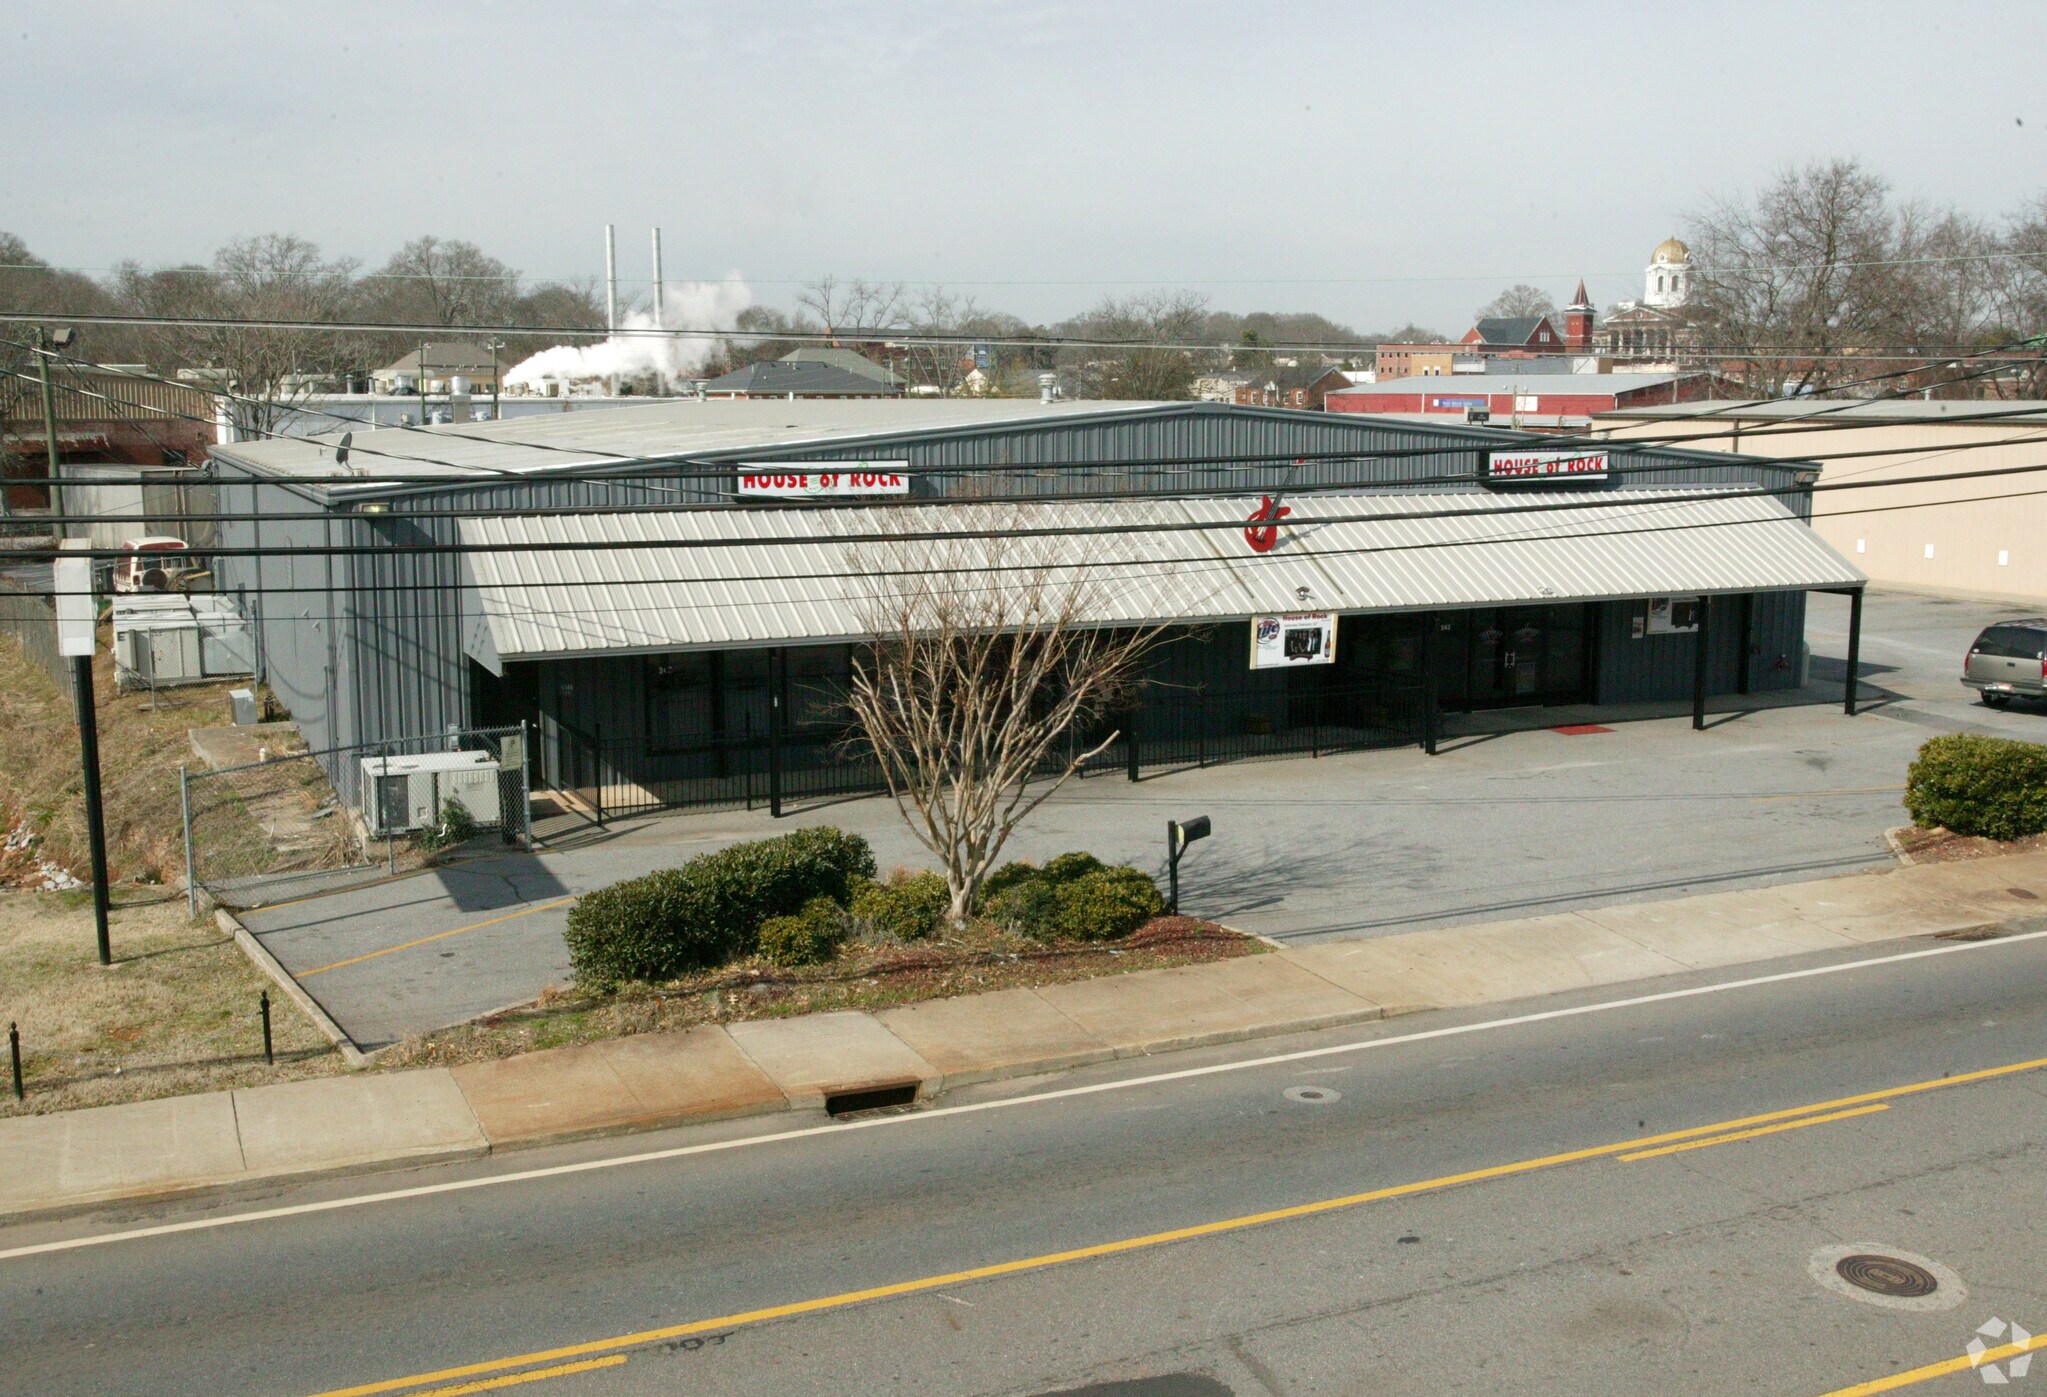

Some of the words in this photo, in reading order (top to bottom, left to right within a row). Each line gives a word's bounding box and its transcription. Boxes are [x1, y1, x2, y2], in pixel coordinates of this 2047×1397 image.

[1494, 458, 1539, 475] HOUSE
[1568, 457, 1603, 473] ROCK
[743, 473, 808, 489] HOUSE
[850, 472, 902, 487] ROCK
